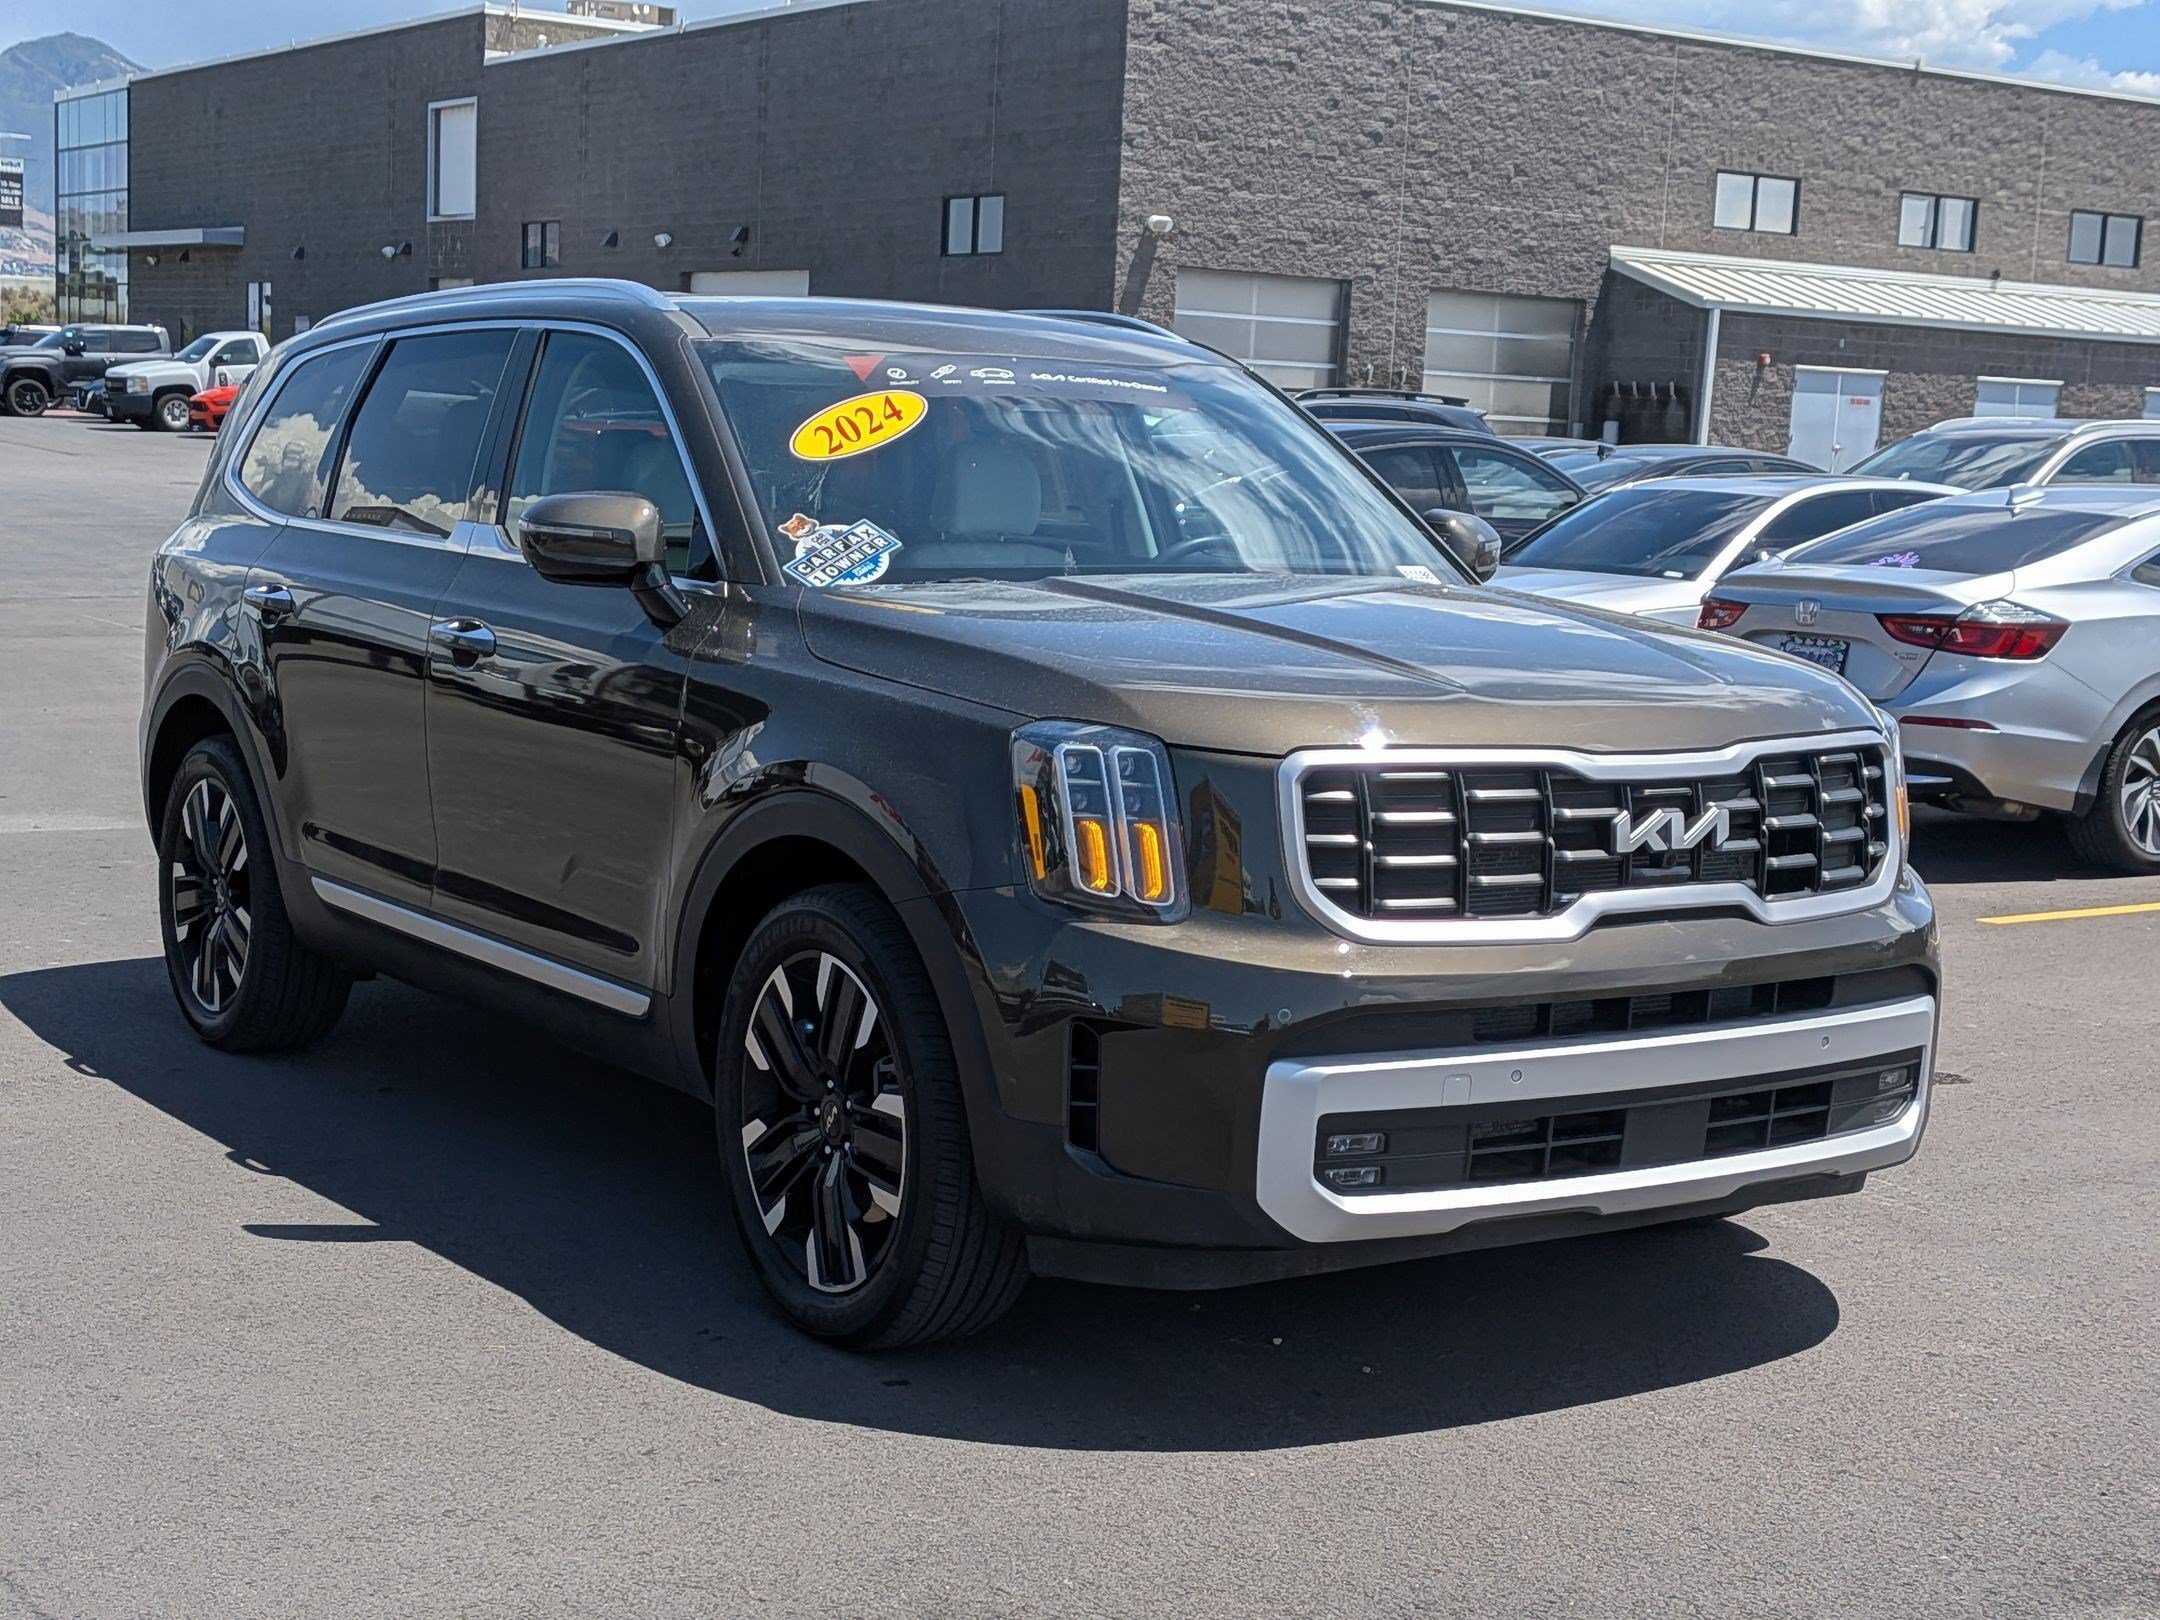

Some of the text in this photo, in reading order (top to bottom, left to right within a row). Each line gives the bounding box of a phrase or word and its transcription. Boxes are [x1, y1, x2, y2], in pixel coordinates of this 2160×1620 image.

[814, 395, 904, 455] 2024
[797, 529, 875, 574] CARFAX
[813, 575, 827, 584] 1
[824, 537, 889, 577] OWNER
[1612, 806, 1730, 853] KIA
